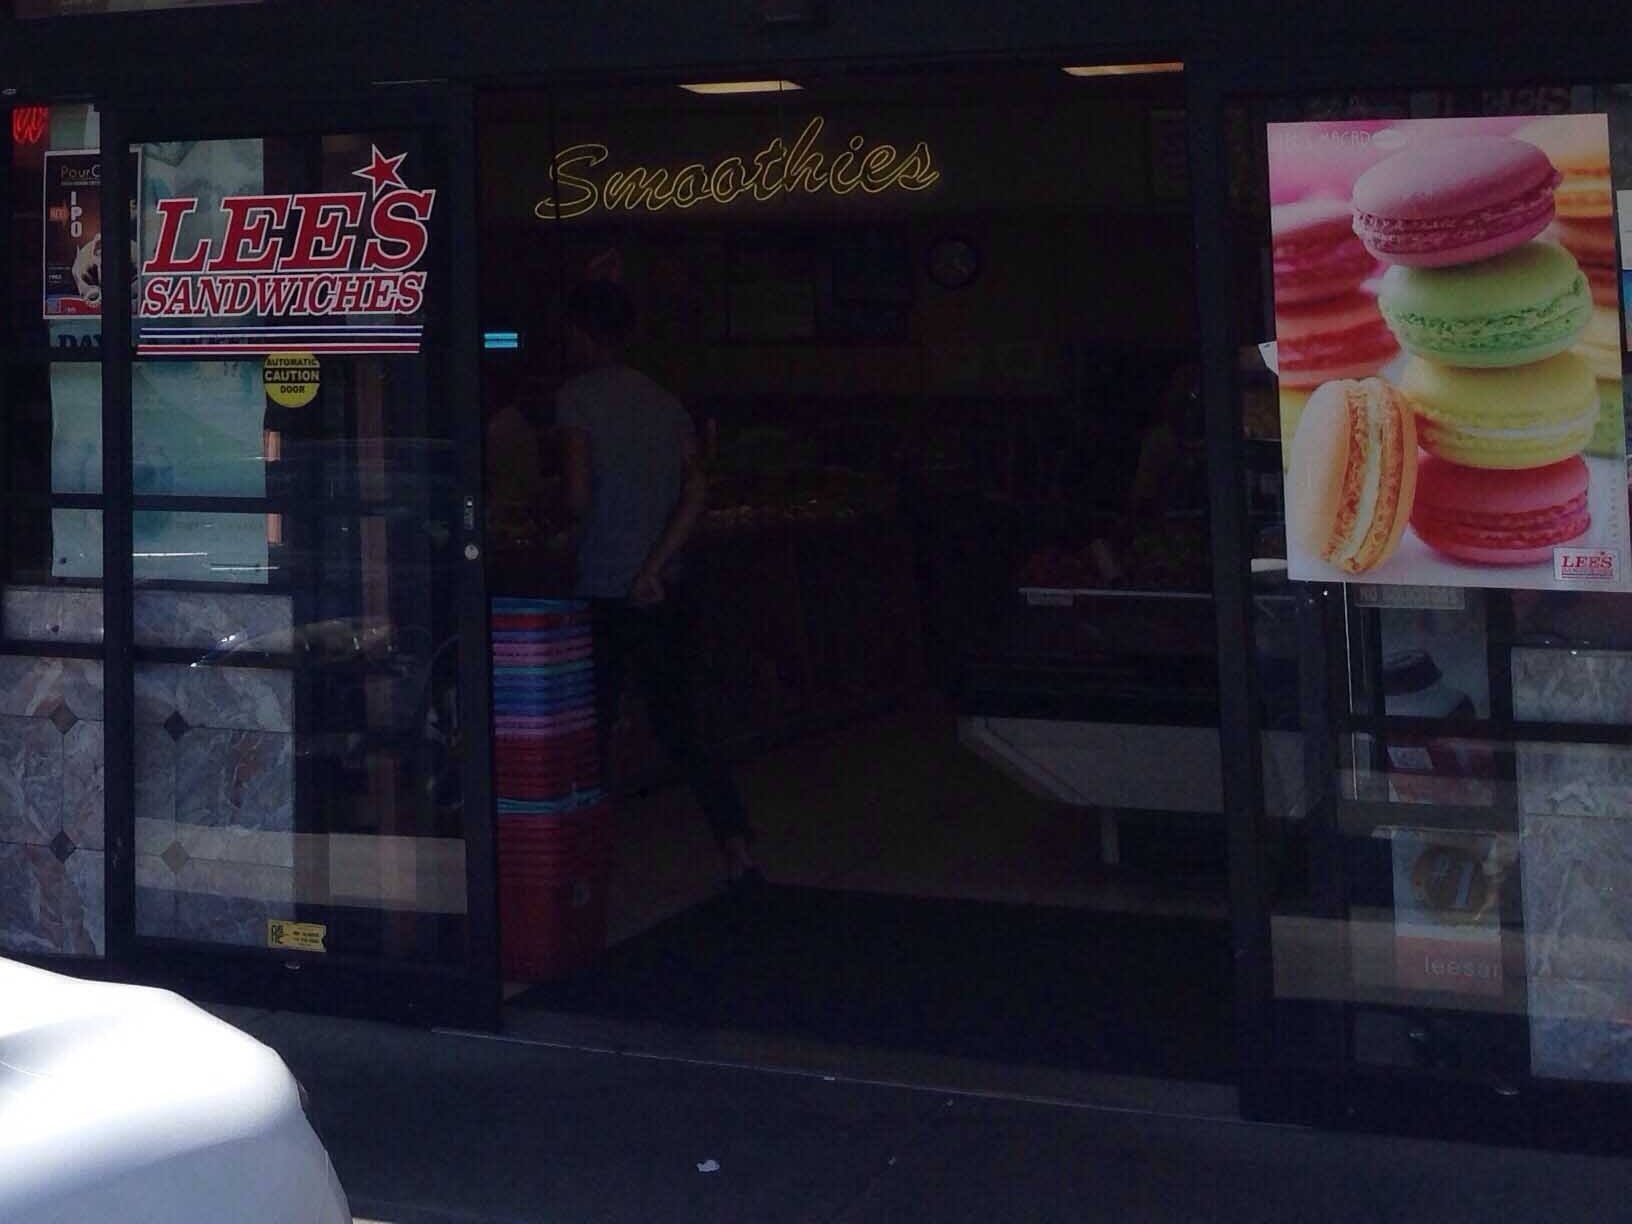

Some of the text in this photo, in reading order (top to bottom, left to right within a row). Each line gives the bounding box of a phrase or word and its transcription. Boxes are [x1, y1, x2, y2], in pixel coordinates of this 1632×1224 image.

[534, 116, 939, 220] Smoothies
[142, 143, 436, 274] LEE'S
[140, 270, 427, 319] SANDWICHES
[264, 369, 320, 382] CAUTION
[266, 358, 318, 367] AUTOMATIC
[279, 384, 306, 394] DOOR
